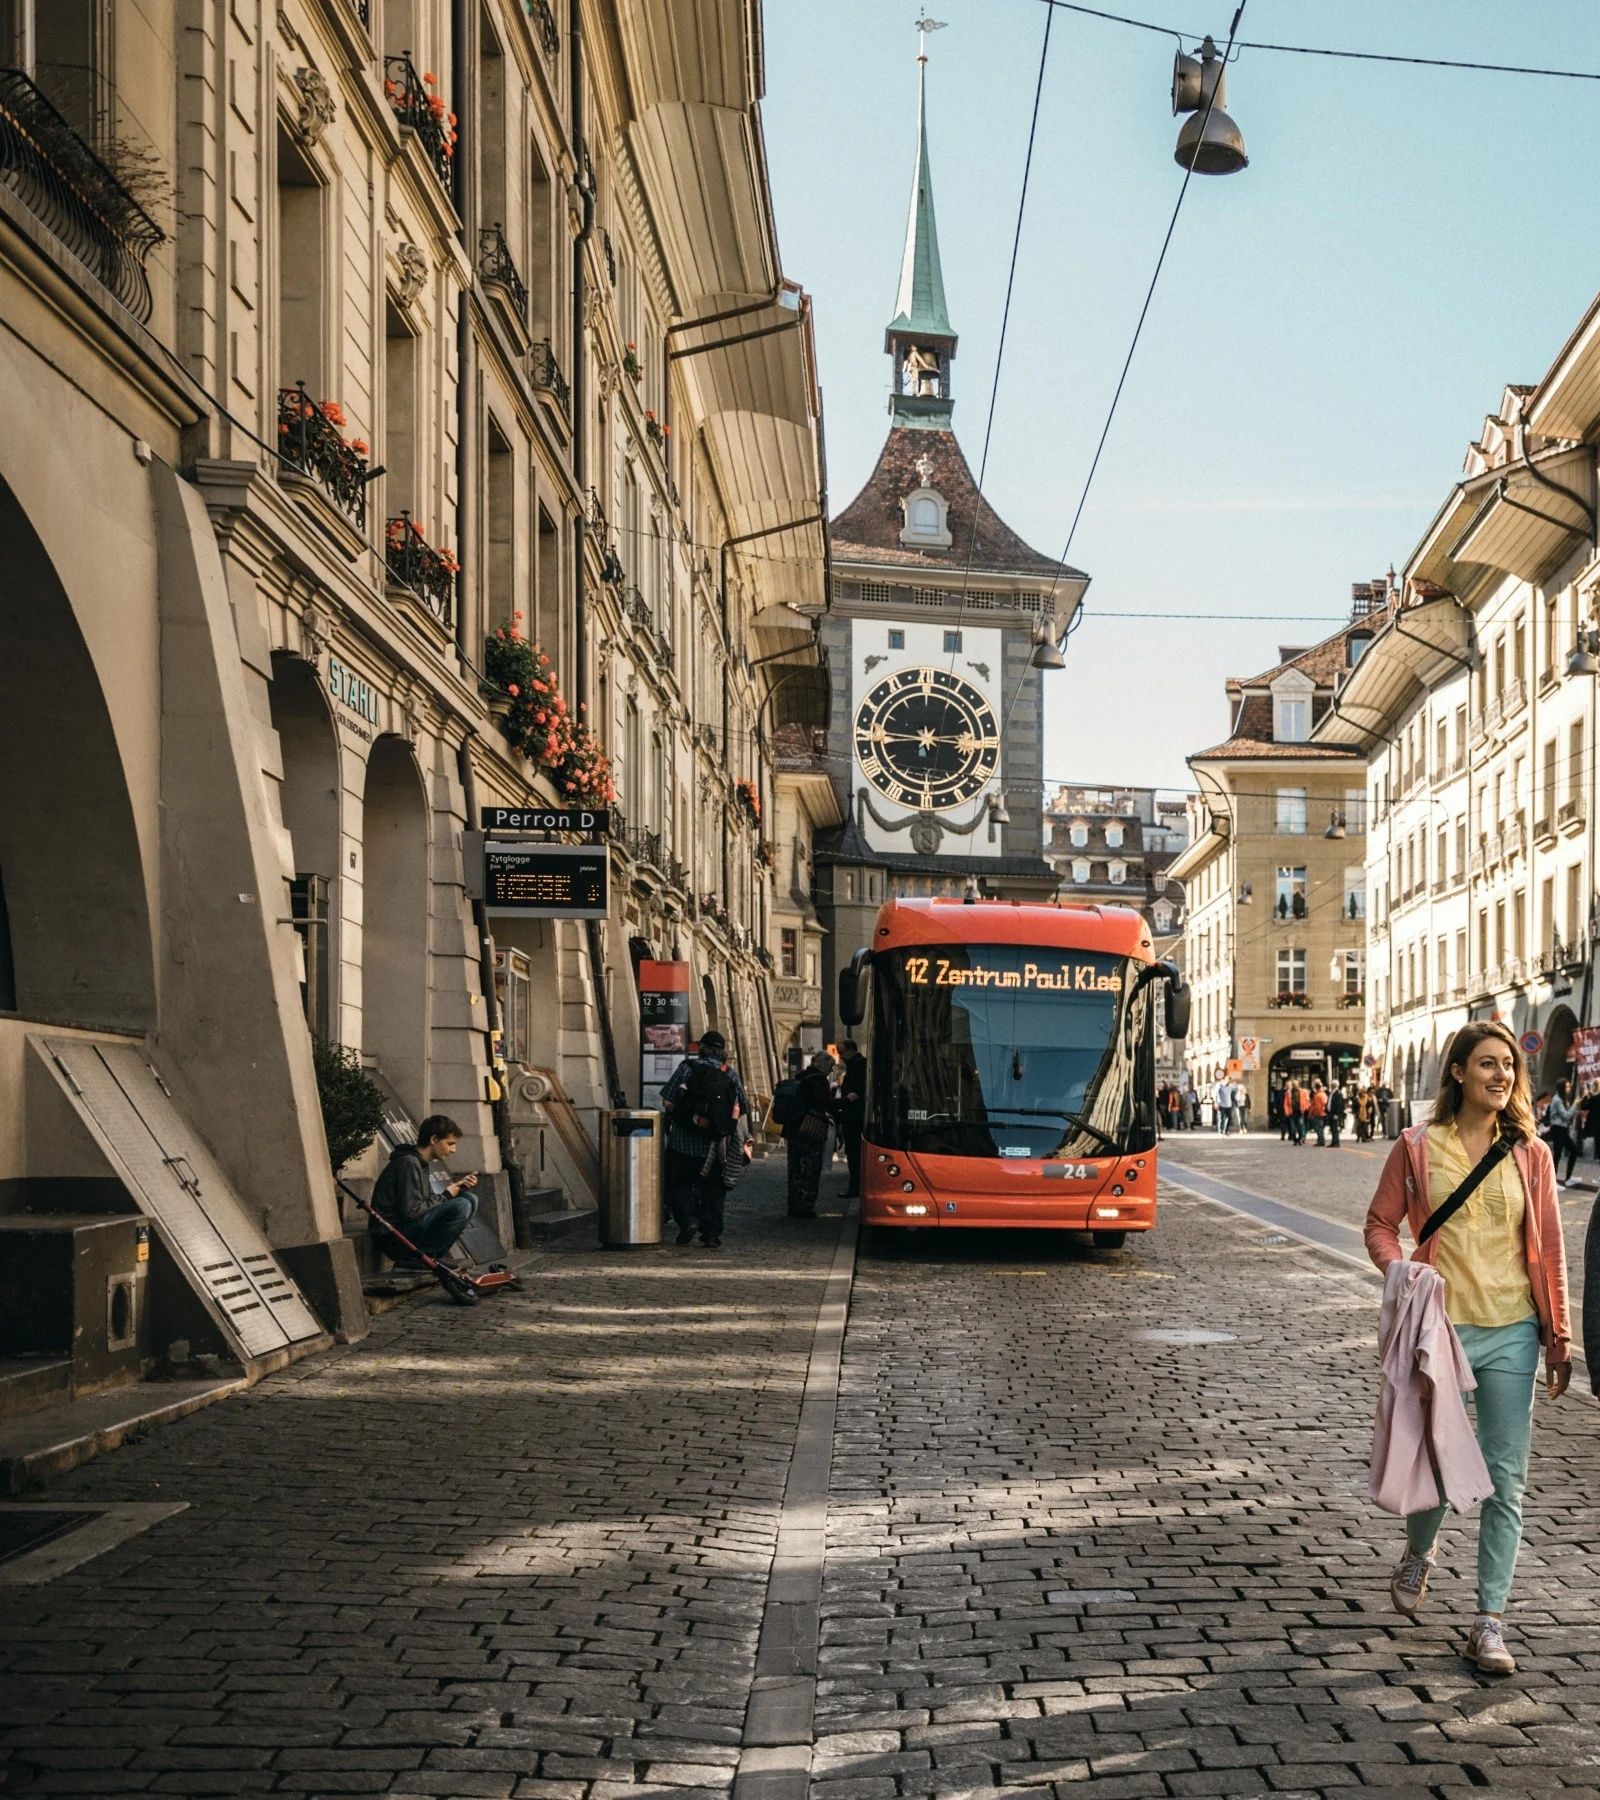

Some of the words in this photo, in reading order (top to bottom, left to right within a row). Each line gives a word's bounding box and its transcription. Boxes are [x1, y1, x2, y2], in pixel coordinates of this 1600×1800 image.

[330, 657, 379, 727] STÄHLI
[496, 810, 570, 828] Perron
[581, 812, 595, 828] D
[905, 958, 929, 984] 12
[936, 960, 1021, 988] Zentrum
[1024, 963, 1071, 989] Paul
[1075, 965, 1122, 991] Klee
[643, 998, 651, 1006] 12
[657, 998, 667, 1006] 30
[1290, 1024, 1360, 1033] APOTHEKE
[1063, 1164, 1087, 1180] 24
